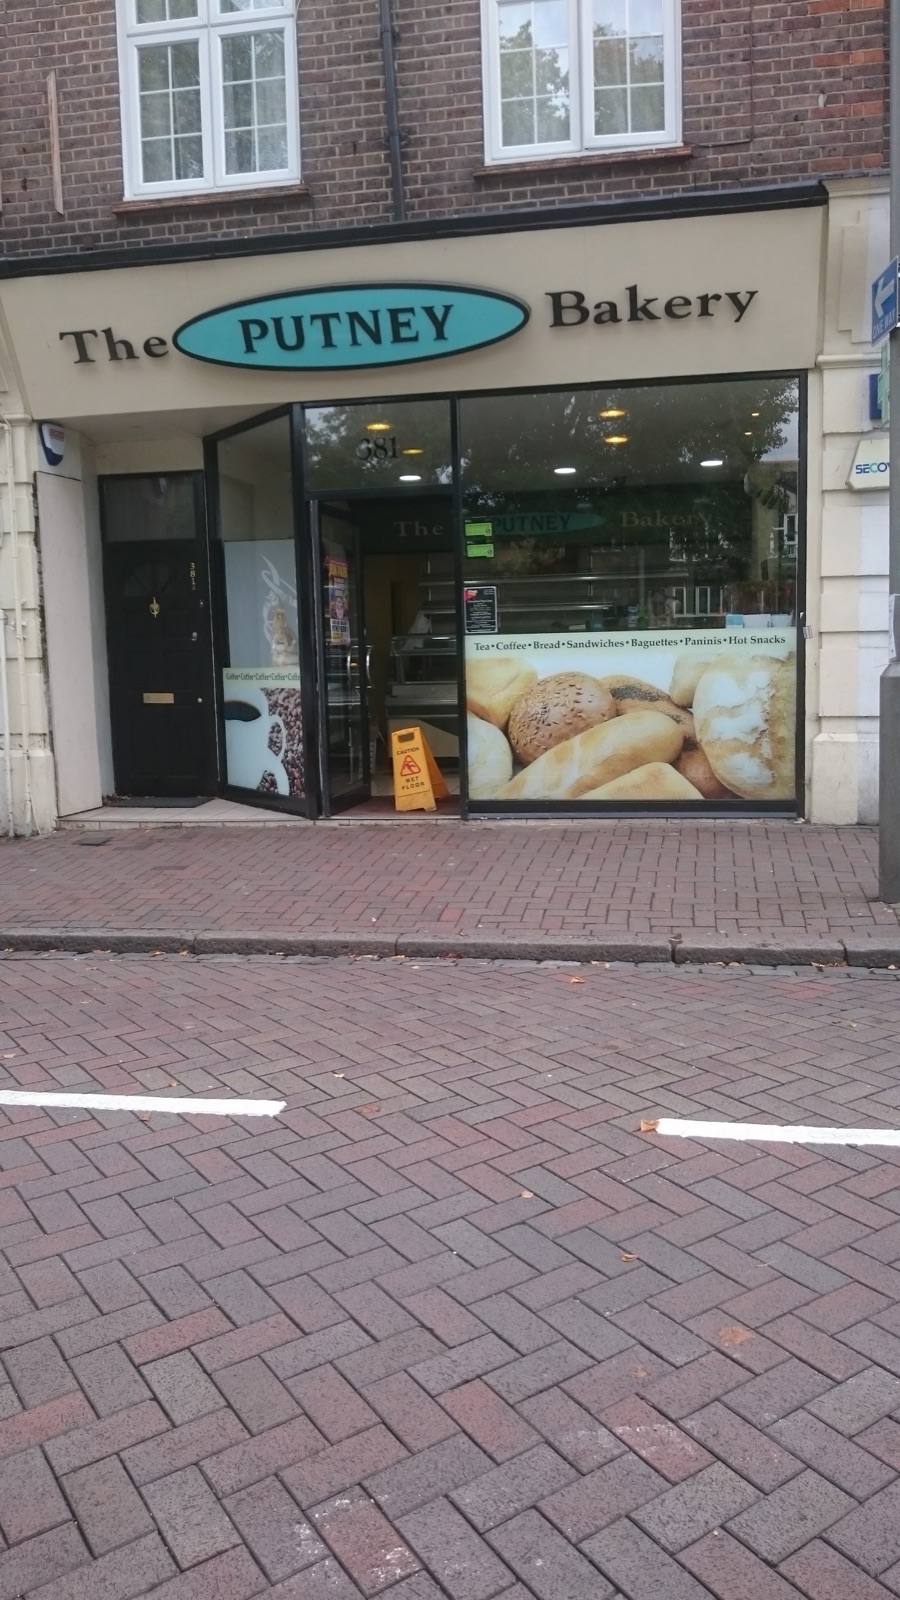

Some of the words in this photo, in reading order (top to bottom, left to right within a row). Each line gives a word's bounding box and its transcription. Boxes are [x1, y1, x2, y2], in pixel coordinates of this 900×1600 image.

[59, 326, 170, 364] The
[238, 305, 453, 354] PUTNEY
[545, 284, 759, 328] Bakery
[873, 319, 883, 339] ONE
[884, 307, 896, 329] WAY
[394, 521, 443, 536] The
[621, 510, 714, 528] Bakery
[728, 635, 747, 645] Hot
[750, 634, 786, 645] Snacks
[396, 747, 419, 755] CAUTION
[401, 781, 425, 790] FLOOR
